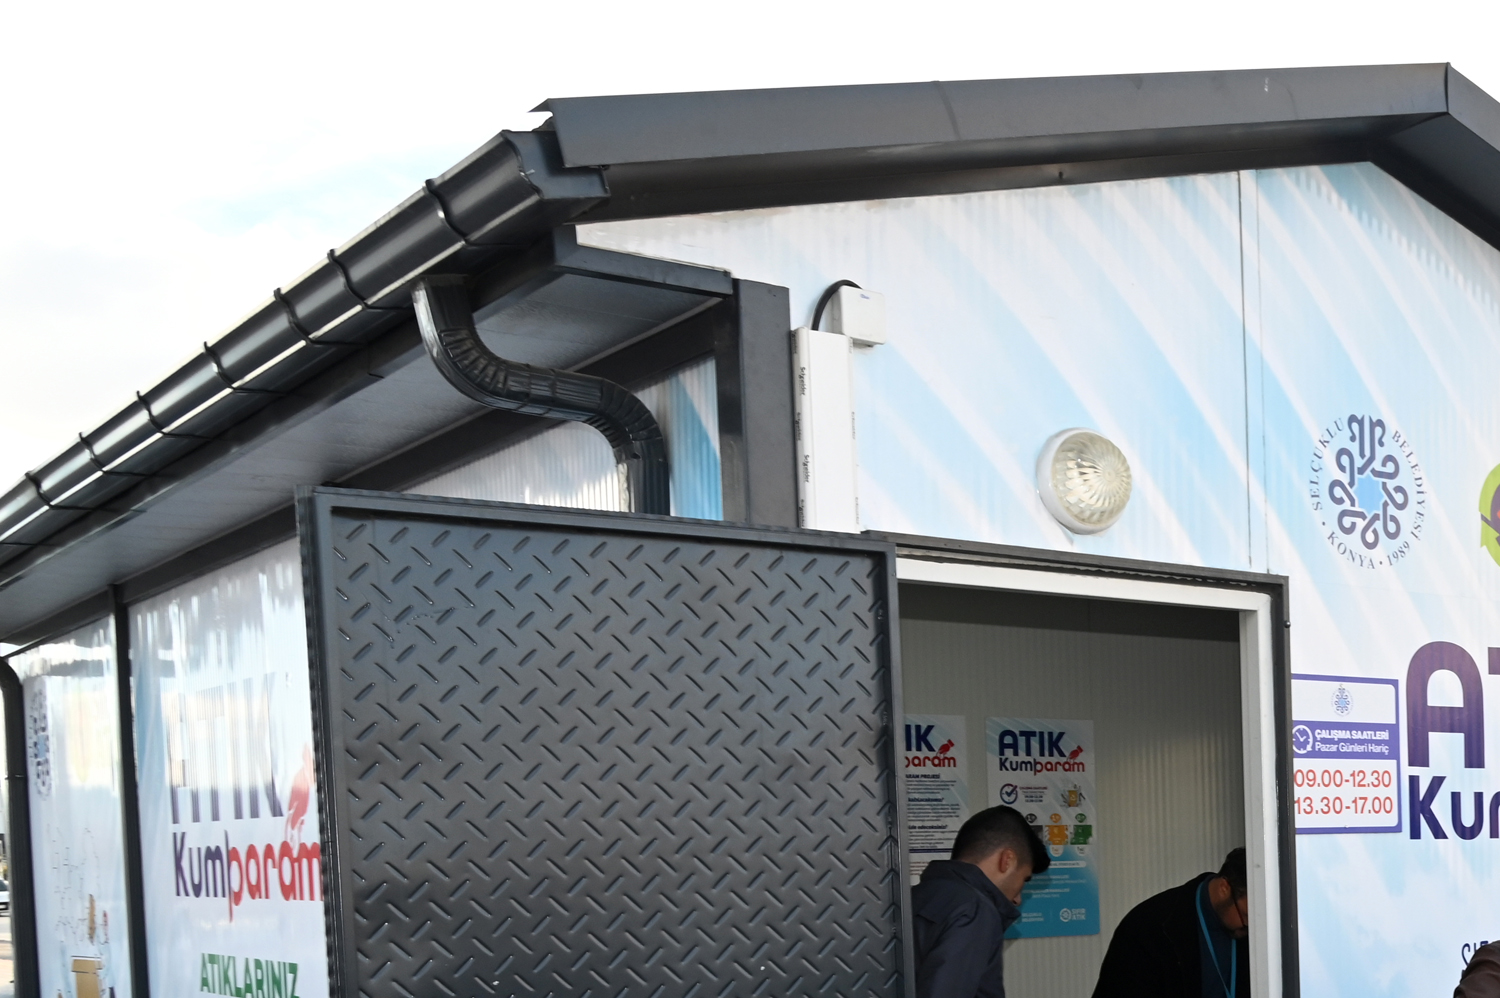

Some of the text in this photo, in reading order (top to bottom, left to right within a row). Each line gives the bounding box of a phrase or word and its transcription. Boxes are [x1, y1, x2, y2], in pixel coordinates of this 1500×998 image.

[1309, 417, 1344, 511] SELÇUKLU
[1327, 531, 1376, 569] KONYA
[1387, 541, 1411, 567] 1989
[905, 725, 936, 752] IK
[998, 730, 1066, 757] ATIK
[1314, 729, 1389, 741] ÇALIŞMA SAATLERİ
[1315, 742, 1389, 755] Pazar Günleri Hariç
[905, 755, 957, 768] aram
[1294, 769, 1392, 788] 09.00-12.30
[1294, 796, 1393, 814] 13.30-17.00
